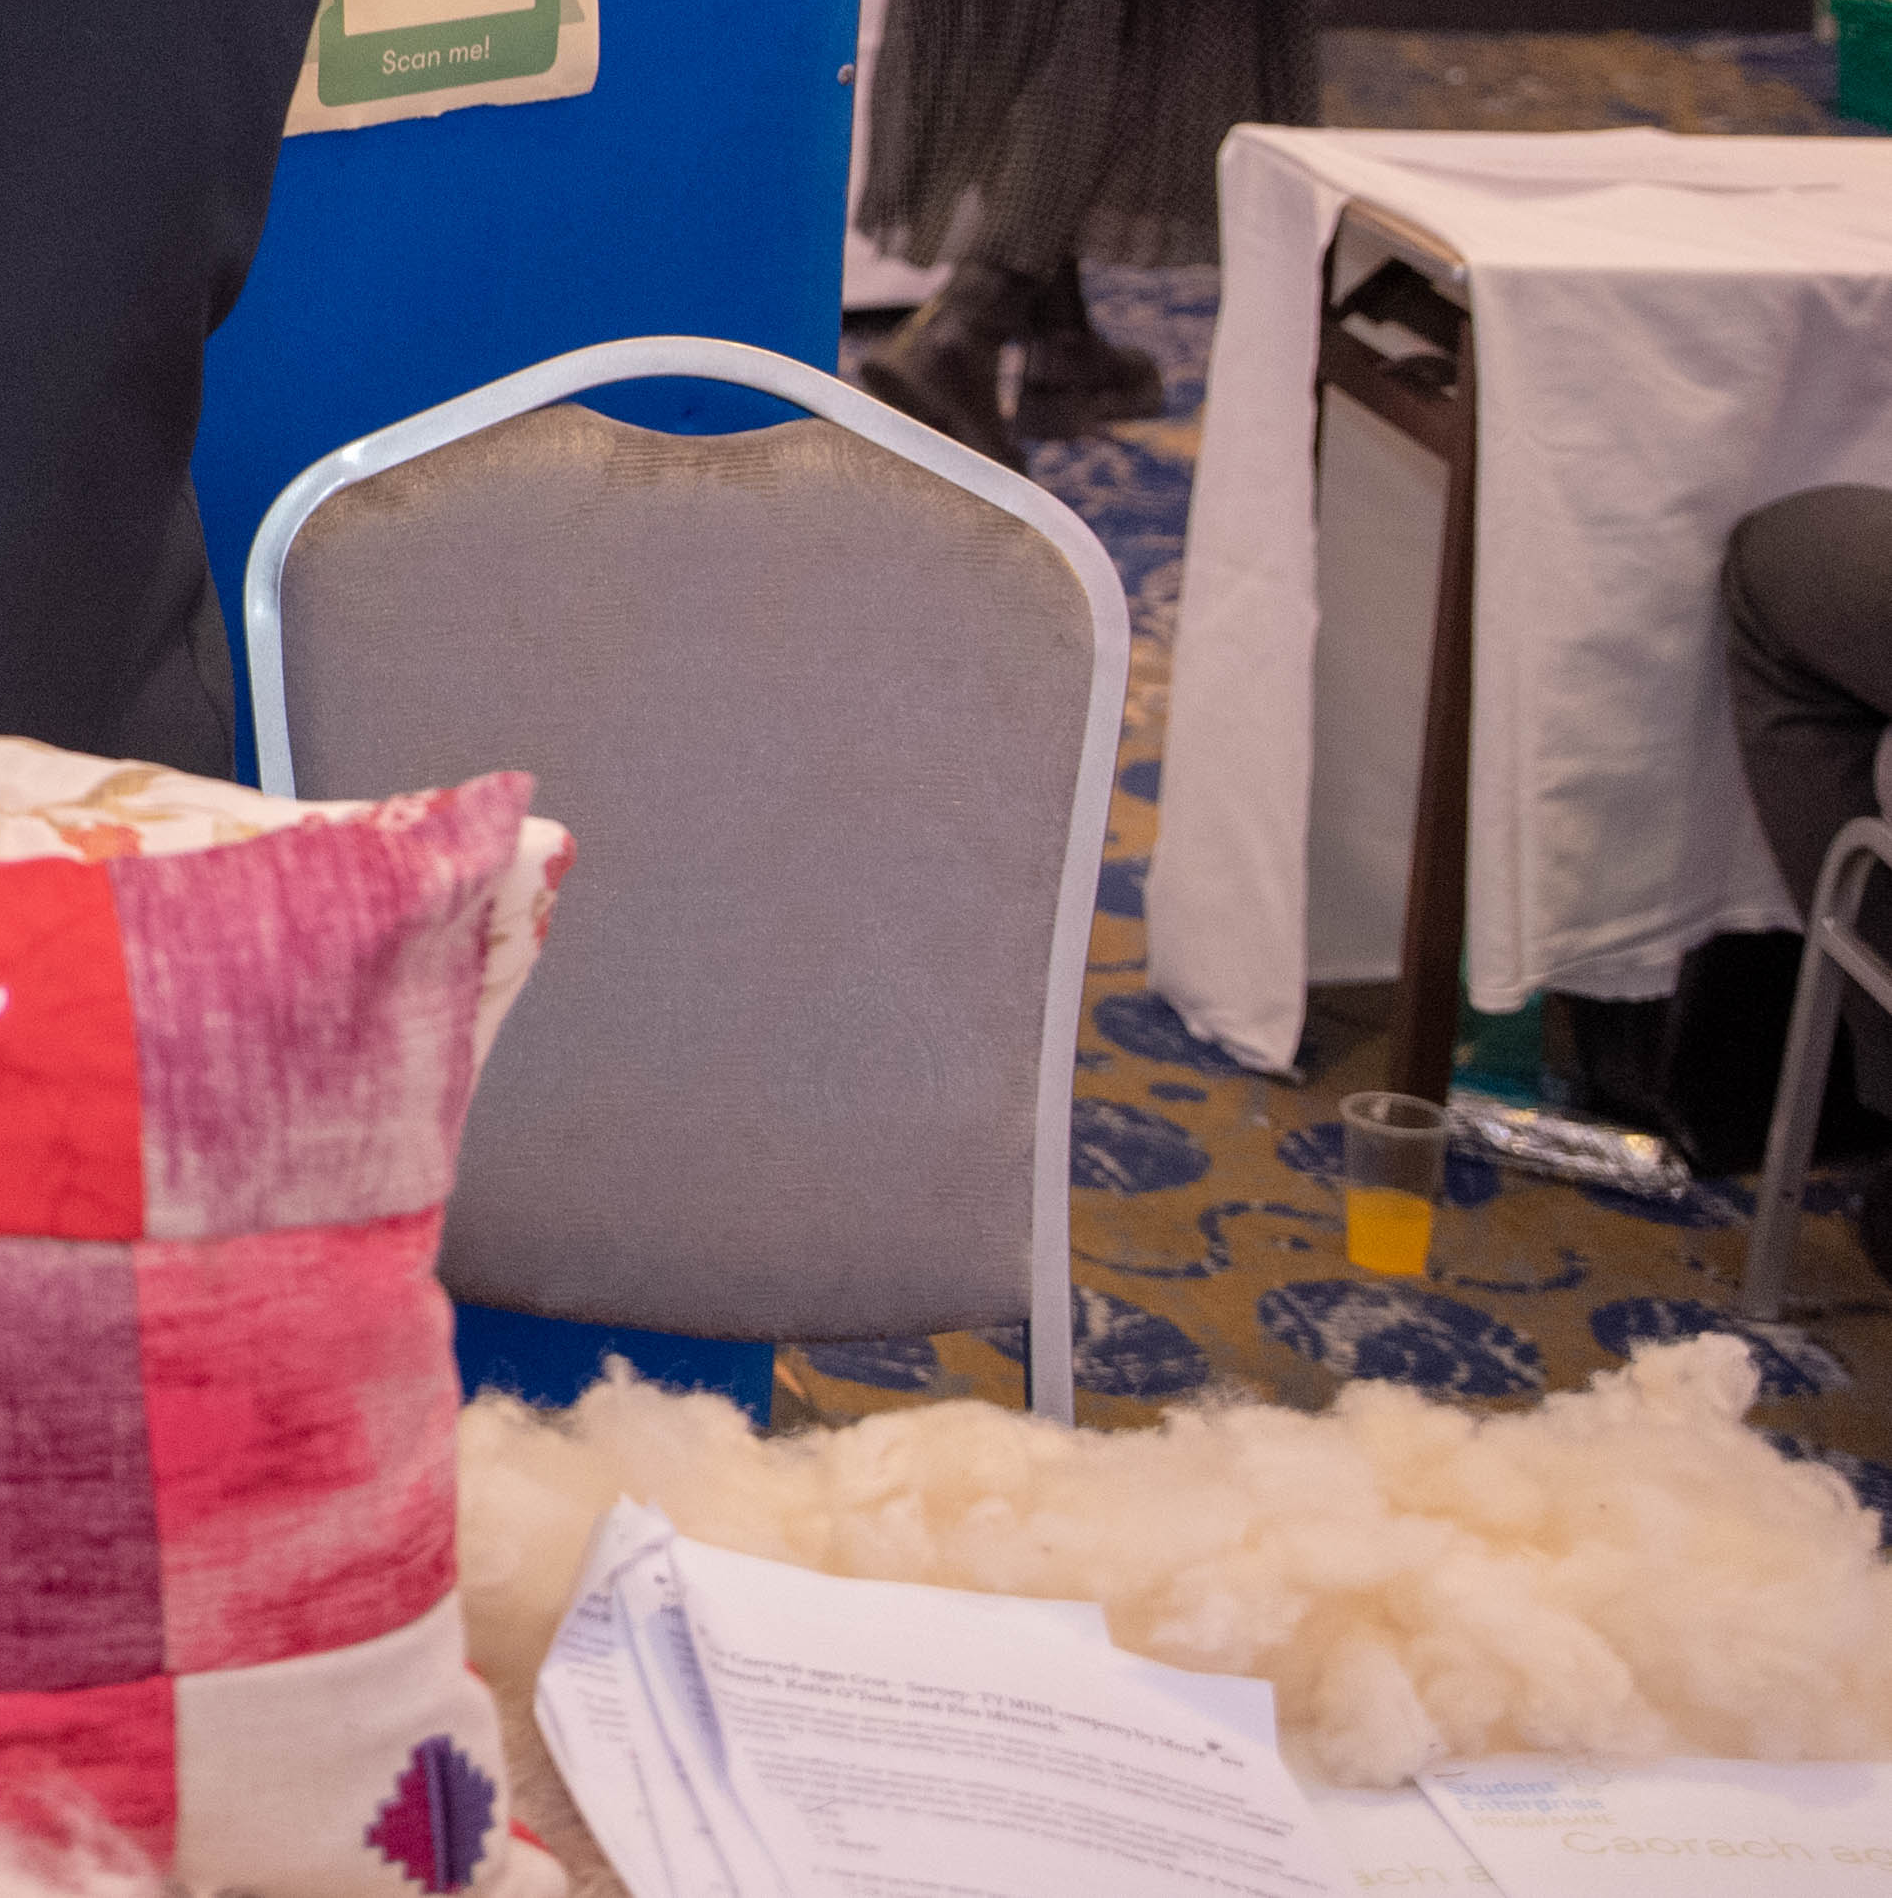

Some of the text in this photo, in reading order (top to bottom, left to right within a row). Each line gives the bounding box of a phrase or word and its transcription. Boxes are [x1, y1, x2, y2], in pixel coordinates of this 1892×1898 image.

[381, 35, 491, 77] Scan me!
[1560, 1830, 1816, 1864] Caorach
